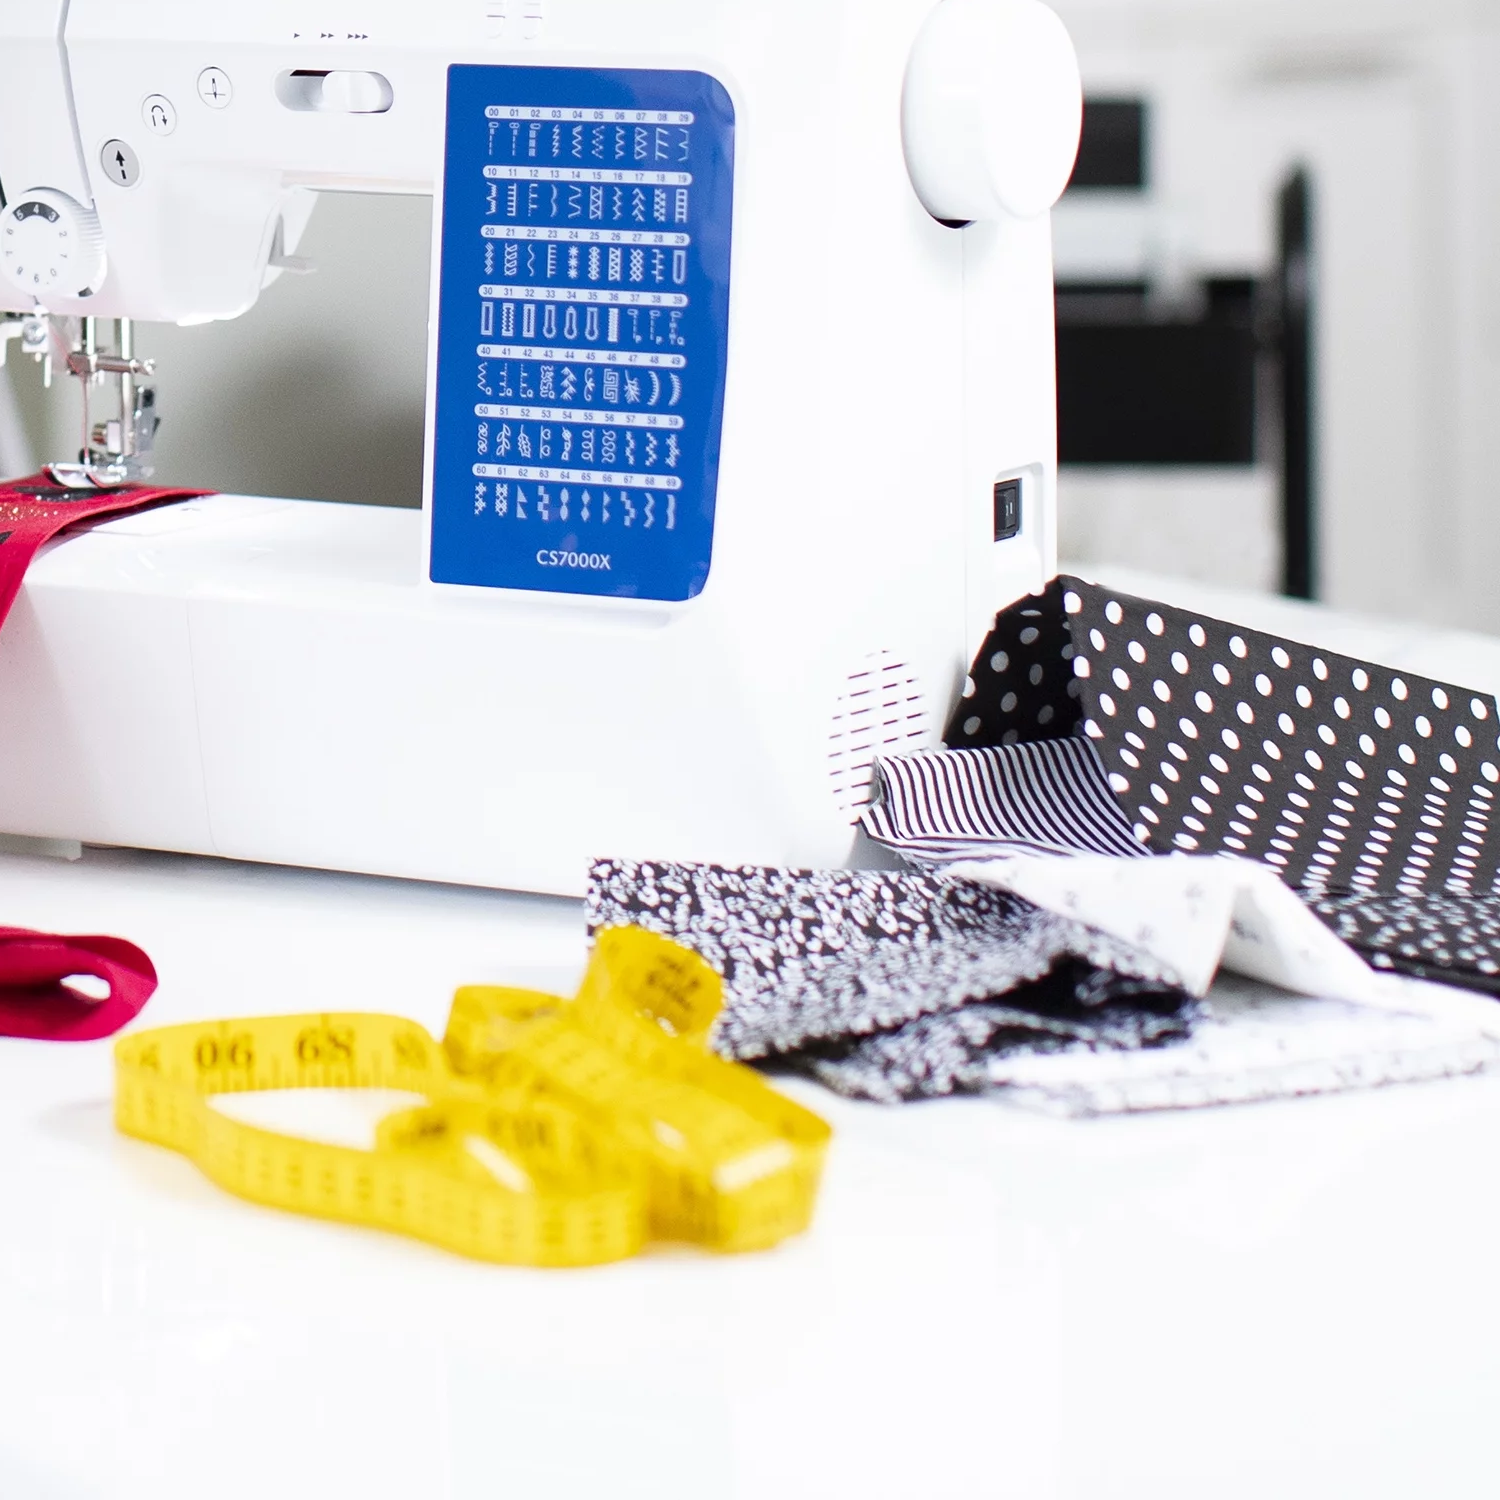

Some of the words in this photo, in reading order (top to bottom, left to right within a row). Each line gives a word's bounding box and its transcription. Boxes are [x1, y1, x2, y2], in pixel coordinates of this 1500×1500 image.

[488, 107, 500, 117] 00
[509, 108, 519, 117] 01
[530, 108, 541, 118] 02
[551, 109, 562, 119] 03
[572, 110, 583, 119] 04
[593, 110, 604, 120] 05
[614, 111, 626, 121] 06
[635, 111, 647, 121] 07
[657, 112, 668, 122] 08
[679, 113, 690, 123] 09
[487, 167, 498, 177] 10
[508, 168, 517, 177] 11
[529, 168, 539, 178] 12
[550, 169, 560, 179] 13
[571, 170, 581, 179] 14
[592, 171, 602, 181] 15
[613, 171, 623, 181] 16
[635, 172, 645, 181] 17
[656, 173, 666, 183] 18
[678, 174, 688, 184] 19
[16, 209, 24, 220] 5
[33, 203, 40, 214] 4
[48, 211, 56, 221] 3
[484, 226, 495, 236] 20
[505, 227, 515, 237] 21
[526, 228, 537, 238] 22
[547, 229, 558, 239] 23
[568, 230, 579, 240] 24
[589, 231, 600, 241] 25
[610, 231, 621, 242] 26
[632, 232, 643, 243] 27
[653, 233, 664, 244] 28
[674, 234, 686, 244] 29
[482, 286, 493, 296] 30
[503, 287, 513, 297] 31
[524, 288, 535, 298] 32
[545, 289, 556, 299] 33
[567, 290, 577, 300] 34
[587, 291, 598, 301] 35
[608, 292, 619, 302] 36
[630, 293, 640, 303] 37
[651, 294, 662, 304] 38
[673, 295, 683, 305] 39
[480, 346, 491, 355] 40
[501, 347, 511, 356] 41
[522, 348, 533, 358] 42
[543, 349, 554, 359] 43
[564, 351, 575, 359] 44
[585, 351, 596, 361] 45
[606, 352, 617, 362] 46
[627, 353, 638, 363] 47
[649, 355, 660, 365] 48
[671, 356, 681, 366] 49
[478, 405, 489, 415] 50
[499, 406, 509, 416] 51
[520, 407, 531, 418] 52
[541, 409, 552, 419] 53
[562, 410, 573, 420] 54
[583, 411, 594, 422] 55
[604, 413, 615, 423] 56
[625, 414, 636, 424] 57
[647, 415, 657, 425] 58
[668, 417, 679, 427] 59
[476, 464, 487, 475] 60
[497, 466, 507, 476] 61
[518, 467, 529, 478] 62
[538, 468, 550, 479] 63
[559, 470, 571, 480] 64
[581, 471, 592, 482] 65
[602, 472, 613, 483] 66
[623, 474, 634, 484] 67
[644, 475, 655, 486] 68
[666, 477, 677, 488] 69
[536, 549, 612, 570] CS7000X
